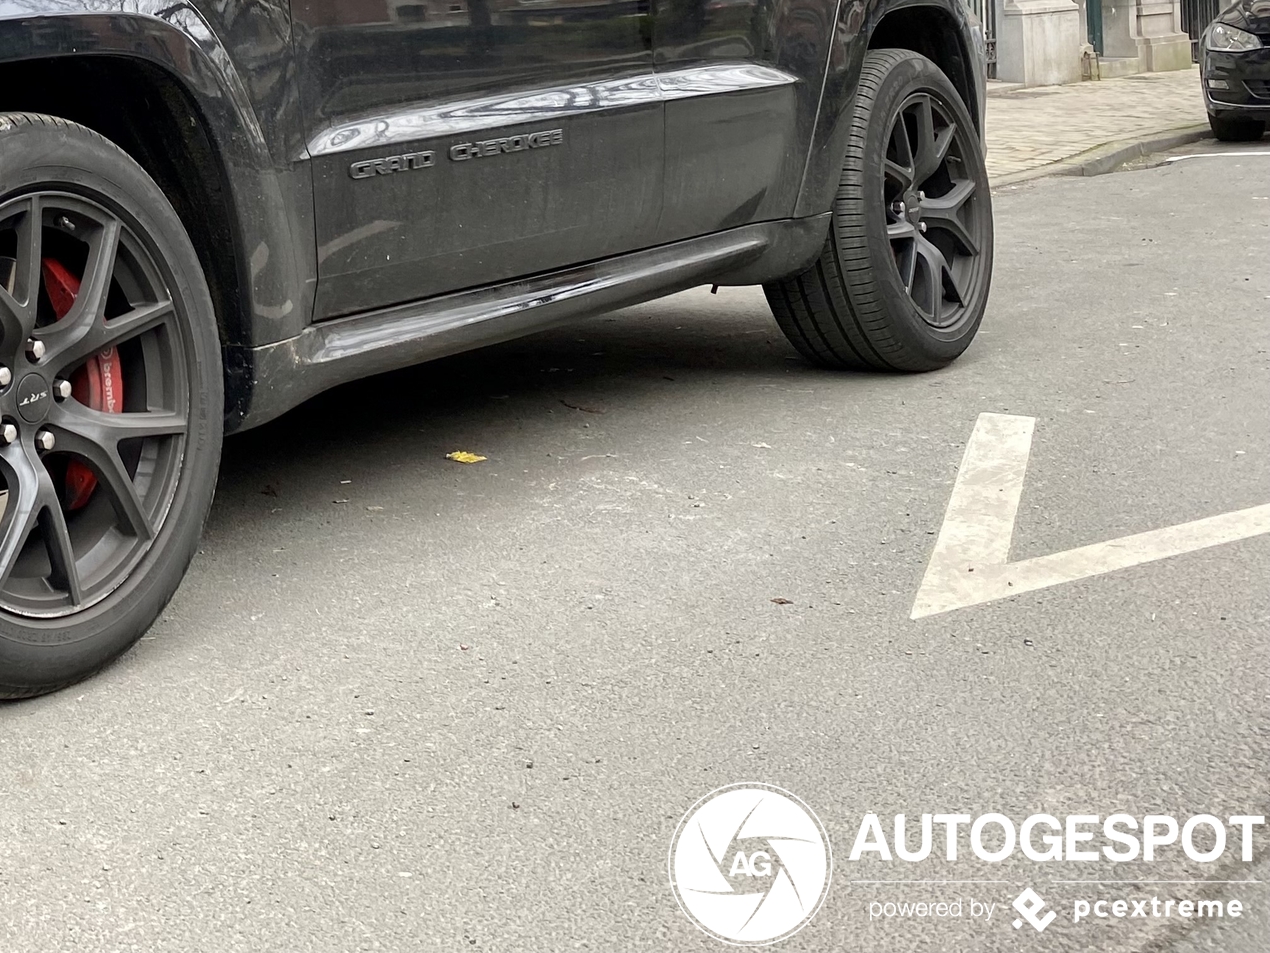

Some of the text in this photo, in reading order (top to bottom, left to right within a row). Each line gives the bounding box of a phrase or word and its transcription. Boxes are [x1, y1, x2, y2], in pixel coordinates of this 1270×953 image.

[350, 128, 563, 180] GRAND CHEROKEE
[19, 390, 49, 406] SRT
